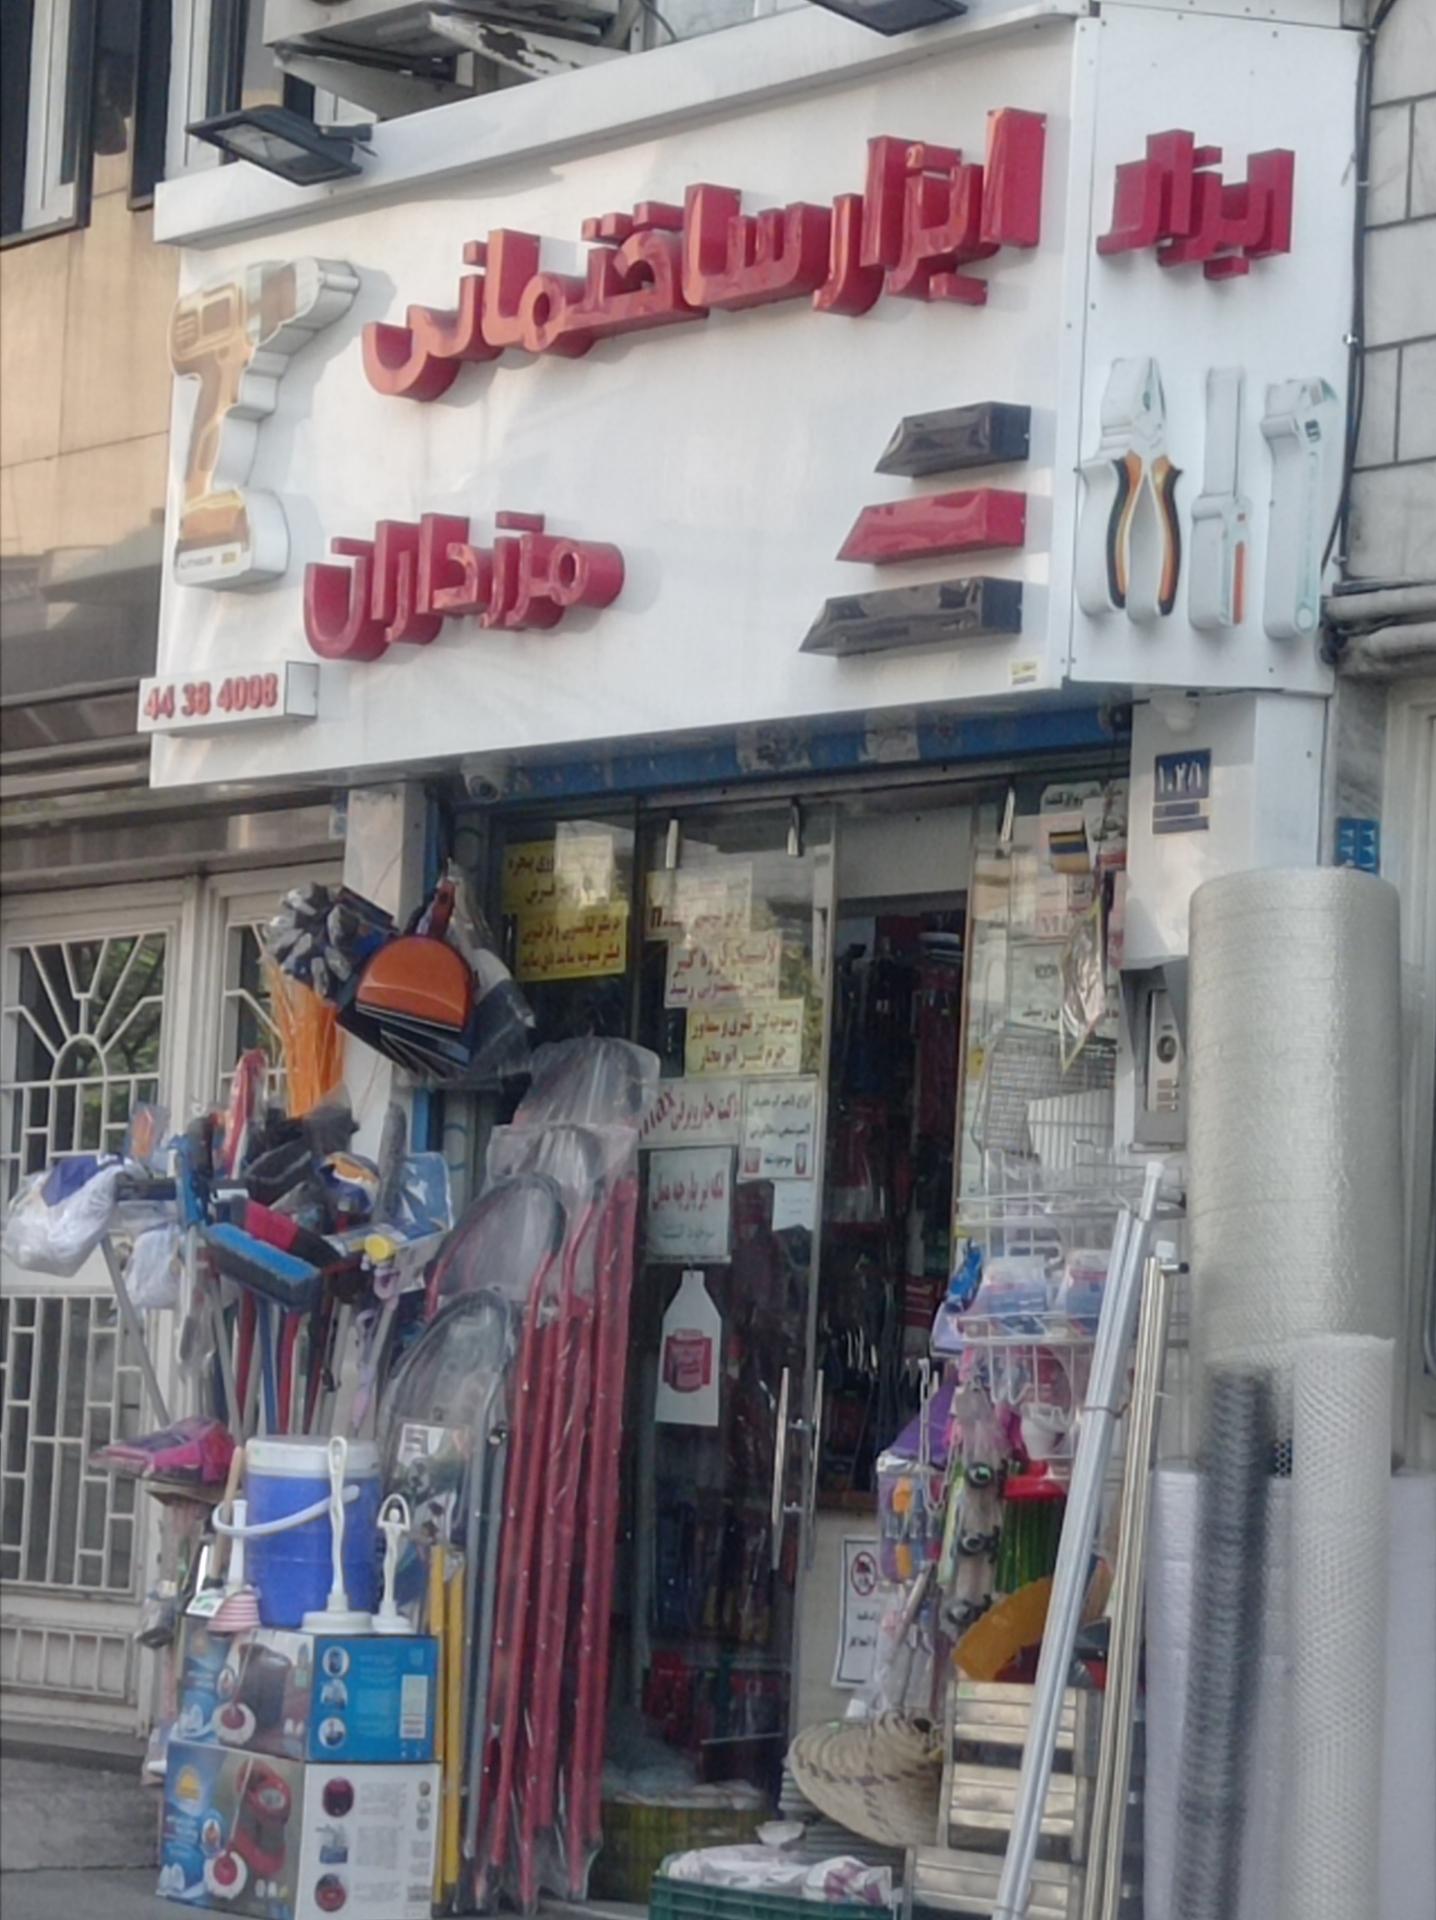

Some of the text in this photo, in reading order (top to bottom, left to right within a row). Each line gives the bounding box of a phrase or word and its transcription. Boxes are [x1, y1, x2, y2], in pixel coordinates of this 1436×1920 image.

[362, 106, 1047, 402] ابزار ساختمانی
[1096, 128, 1296, 281] ابزار
[303, 510, 626, 661] مرزداران
[143, 684, 175, 721] 44
